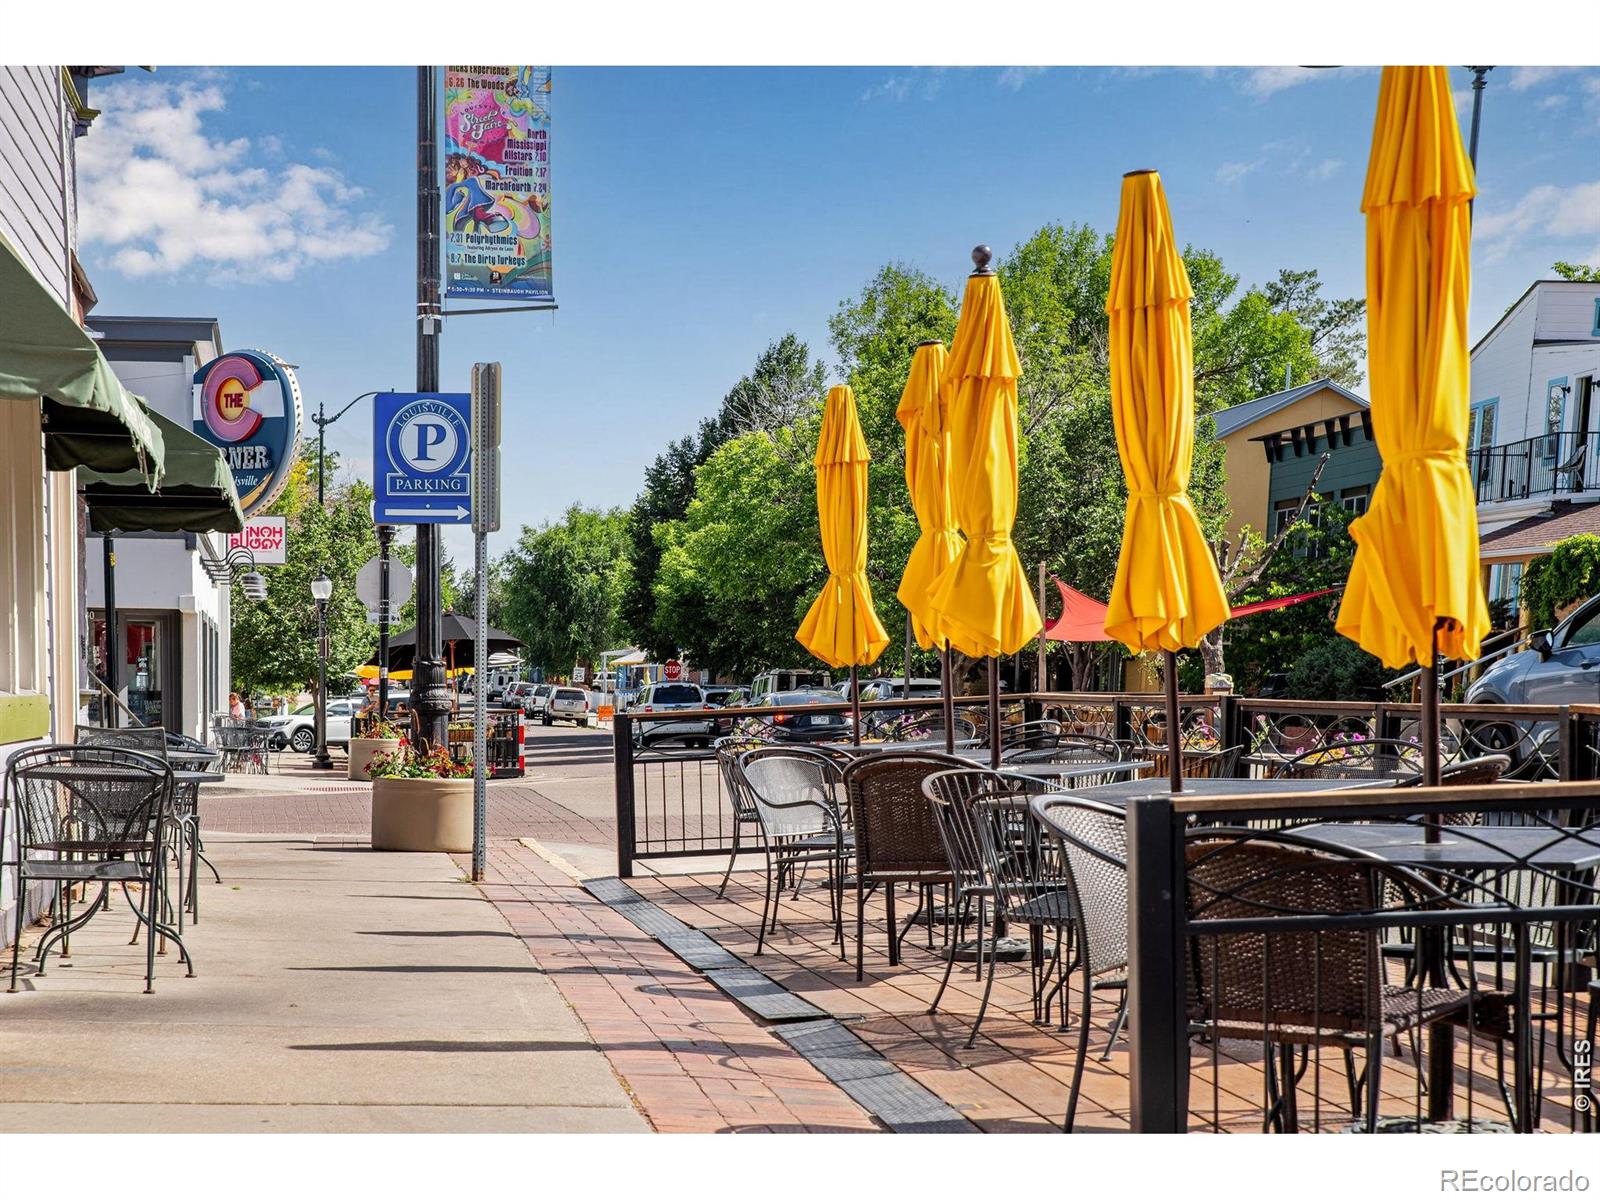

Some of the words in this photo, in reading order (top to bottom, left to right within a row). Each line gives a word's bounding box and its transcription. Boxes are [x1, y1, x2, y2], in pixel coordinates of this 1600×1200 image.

[467, 78, 480, 89] The
[481, 79, 505, 90] Woods
[507, 139, 547, 151] Mississippi
[504, 149, 533, 161] Allstars
[505, 165, 533, 177] Fruition
[485, 180, 531, 192] MarchFourth
[450, 233, 463, 243] 7.31
[465, 233, 518, 246] Polyrhythmics
[450, 253, 461, 264] 8.7
[464, 253, 477, 264] The
[477, 254, 496, 266] Dirty
[497, 254, 526, 267] Turkeys
[224, 393, 244, 409] THE
[395, 403, 461, 428] LOUISVILLE
[411, 423, 447, 461] P
[395, 478, 462, 491] PARKING
[665, 666, 682, 675] STOP
